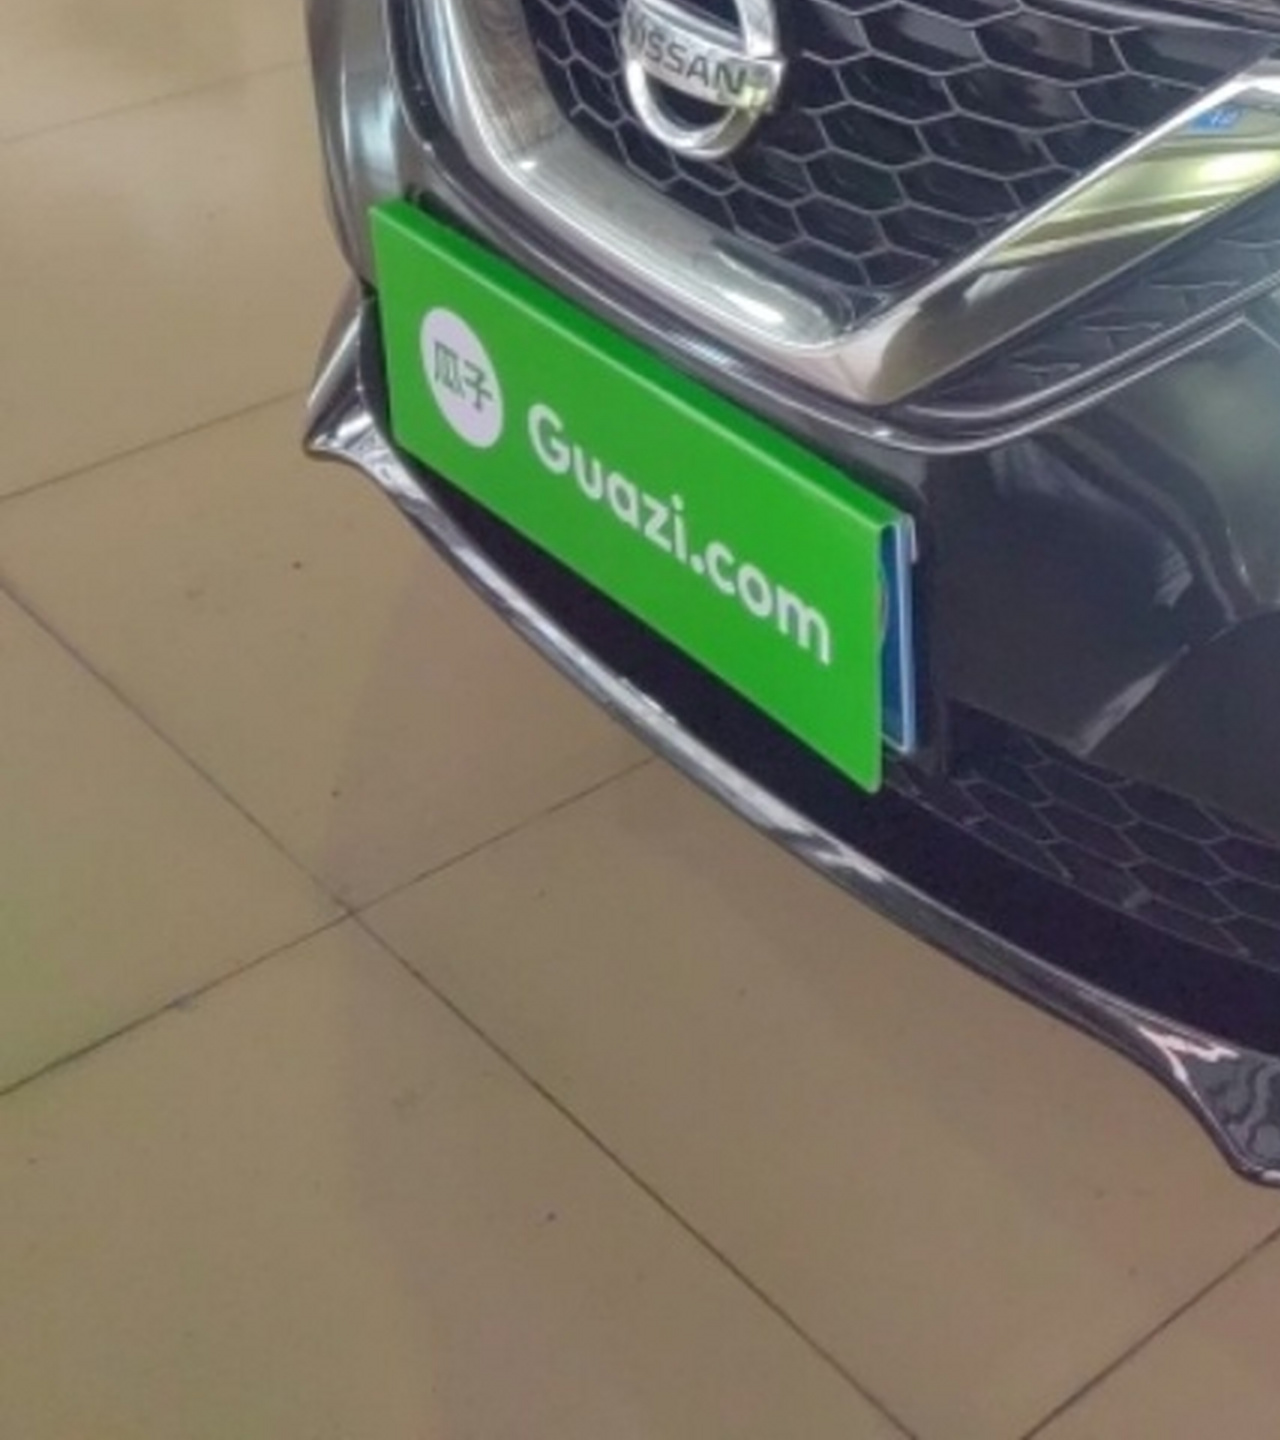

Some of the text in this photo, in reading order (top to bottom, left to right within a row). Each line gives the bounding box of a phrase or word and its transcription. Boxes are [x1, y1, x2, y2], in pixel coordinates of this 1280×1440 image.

[627, 17, 748, 96] NISSAN
[434, 340, 494, 412] 瓜子
[528, 403, 831, 666] Guazi.com
